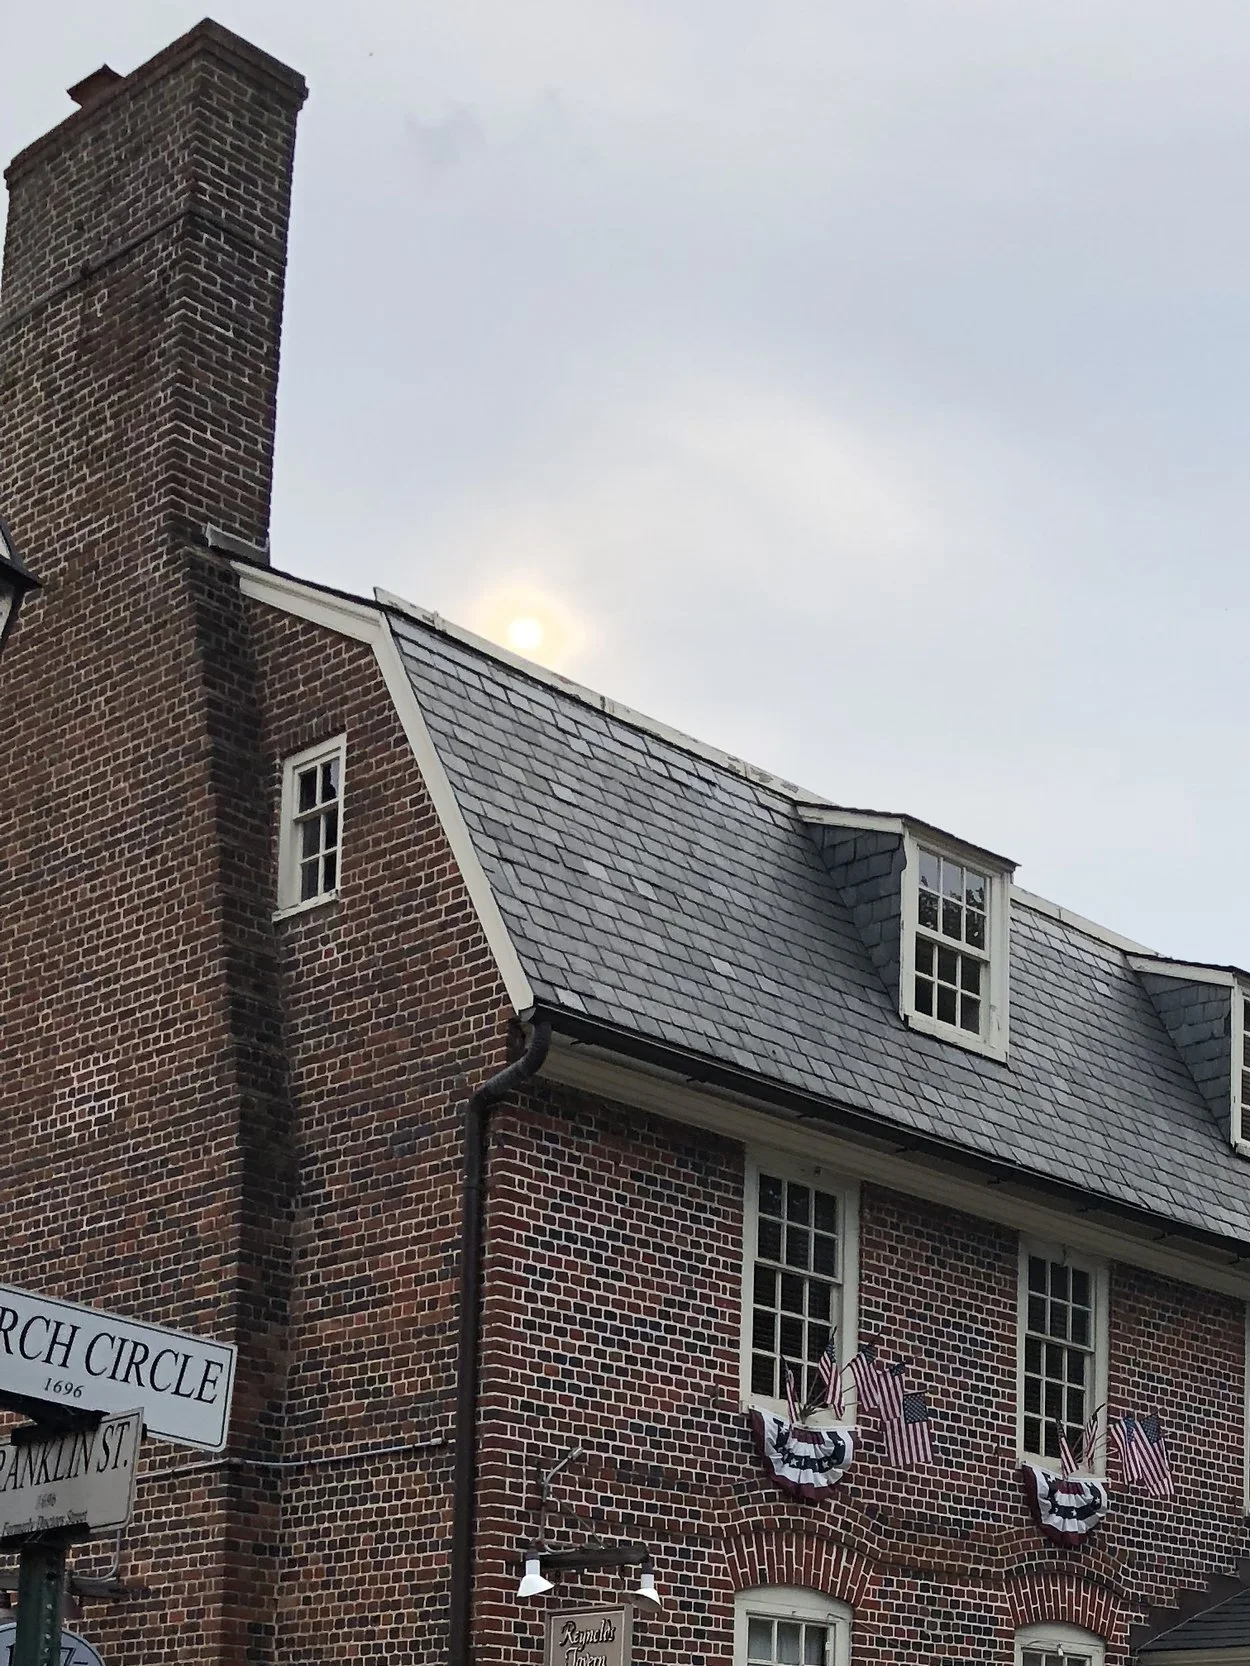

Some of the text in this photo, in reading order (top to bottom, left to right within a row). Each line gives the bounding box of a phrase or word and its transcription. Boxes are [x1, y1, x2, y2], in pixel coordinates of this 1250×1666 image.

[44, 1377, 83, 1398] 1696
[85, 1332, 223, 1404] CIRCLE
[96, 1421, 130, 1473] ST.
[559, 1618, 617, 1652] Reynolds
